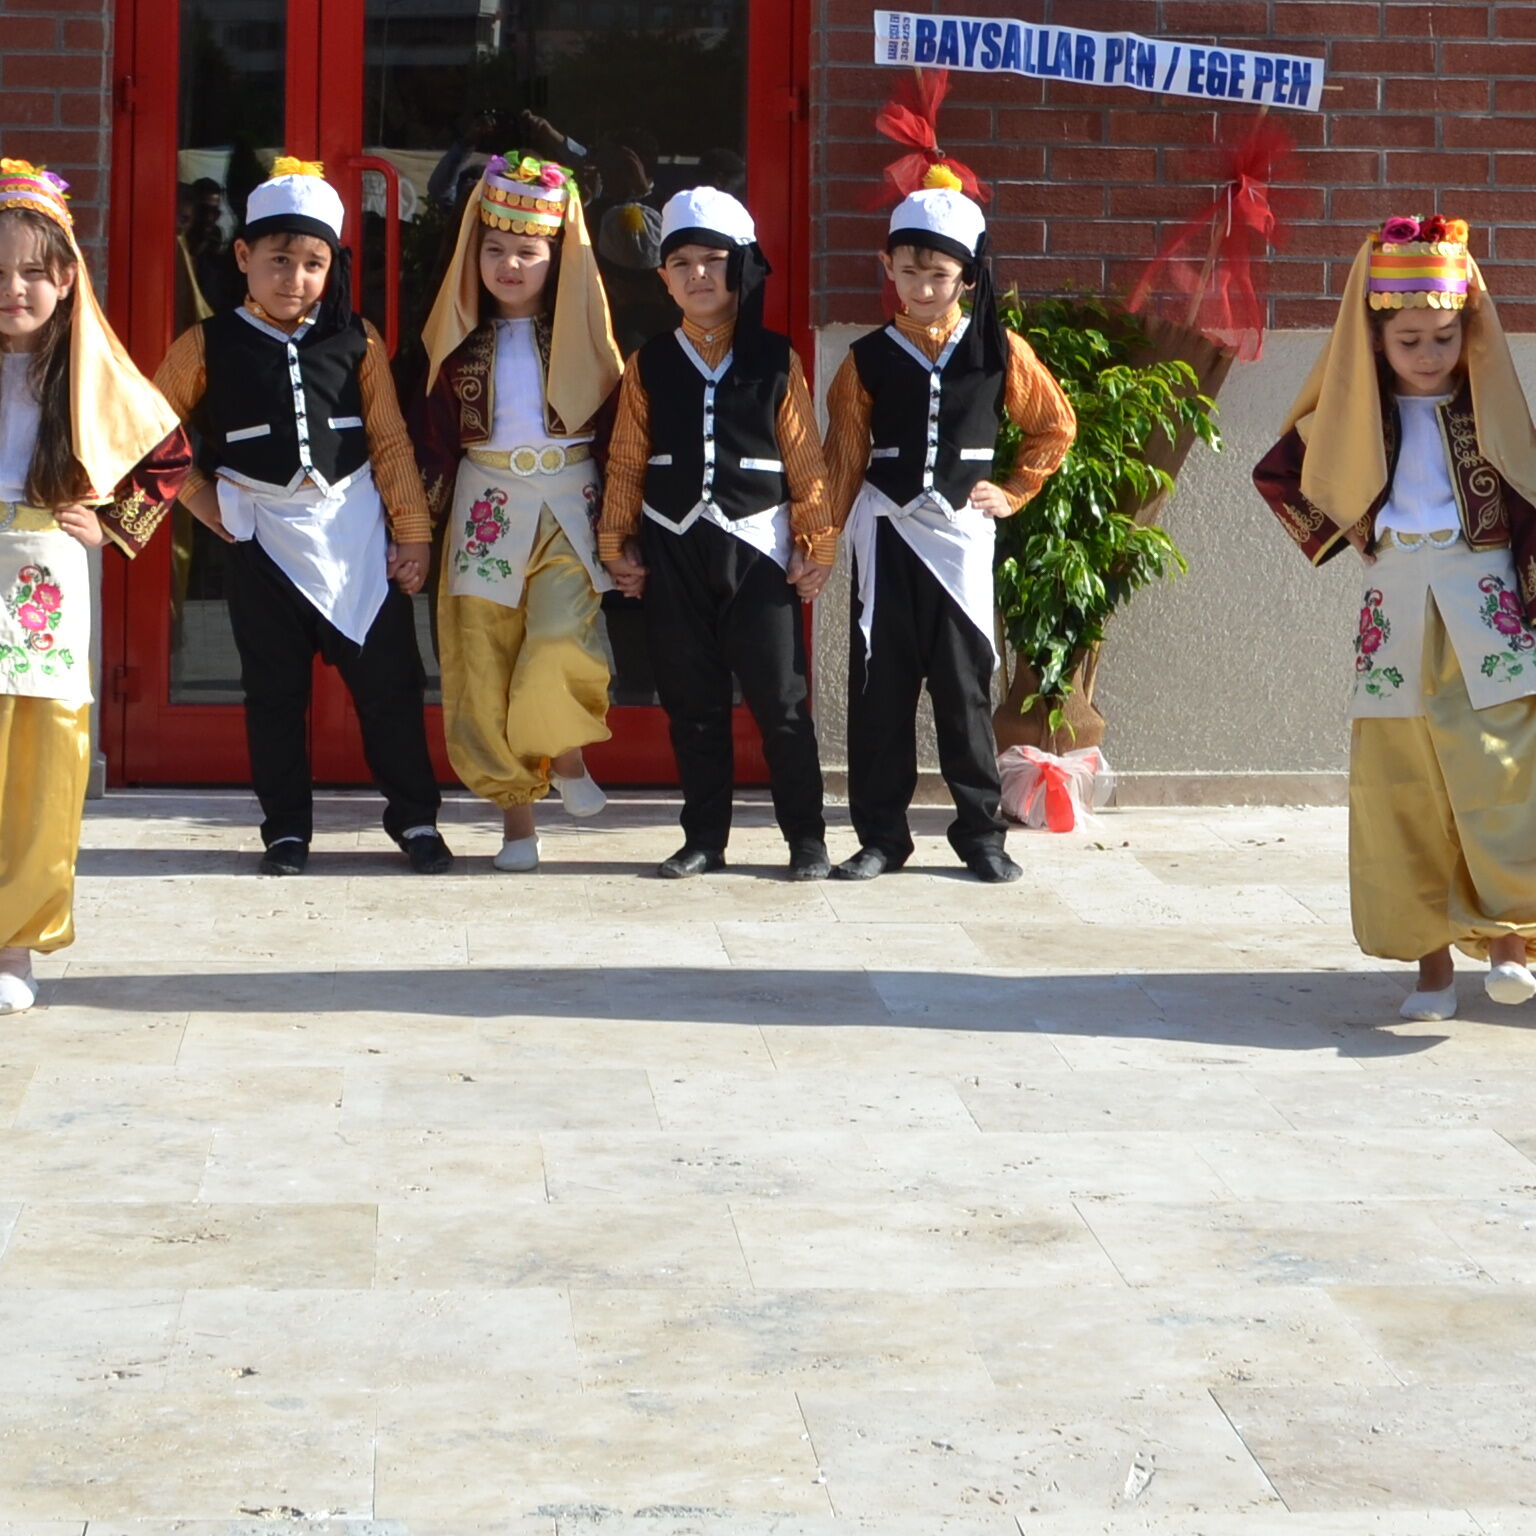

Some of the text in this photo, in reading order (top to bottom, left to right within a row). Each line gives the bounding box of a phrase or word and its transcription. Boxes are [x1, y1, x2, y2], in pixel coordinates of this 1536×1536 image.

[914, 18, 1096, 81] BAYSALLAR
[1103, 37, 1157, 88] PEN
[1162, 46, 1181, 91] /
[1187, 49, 1246, 99] EGE
[1252, 56, 1312, 106] PEN
